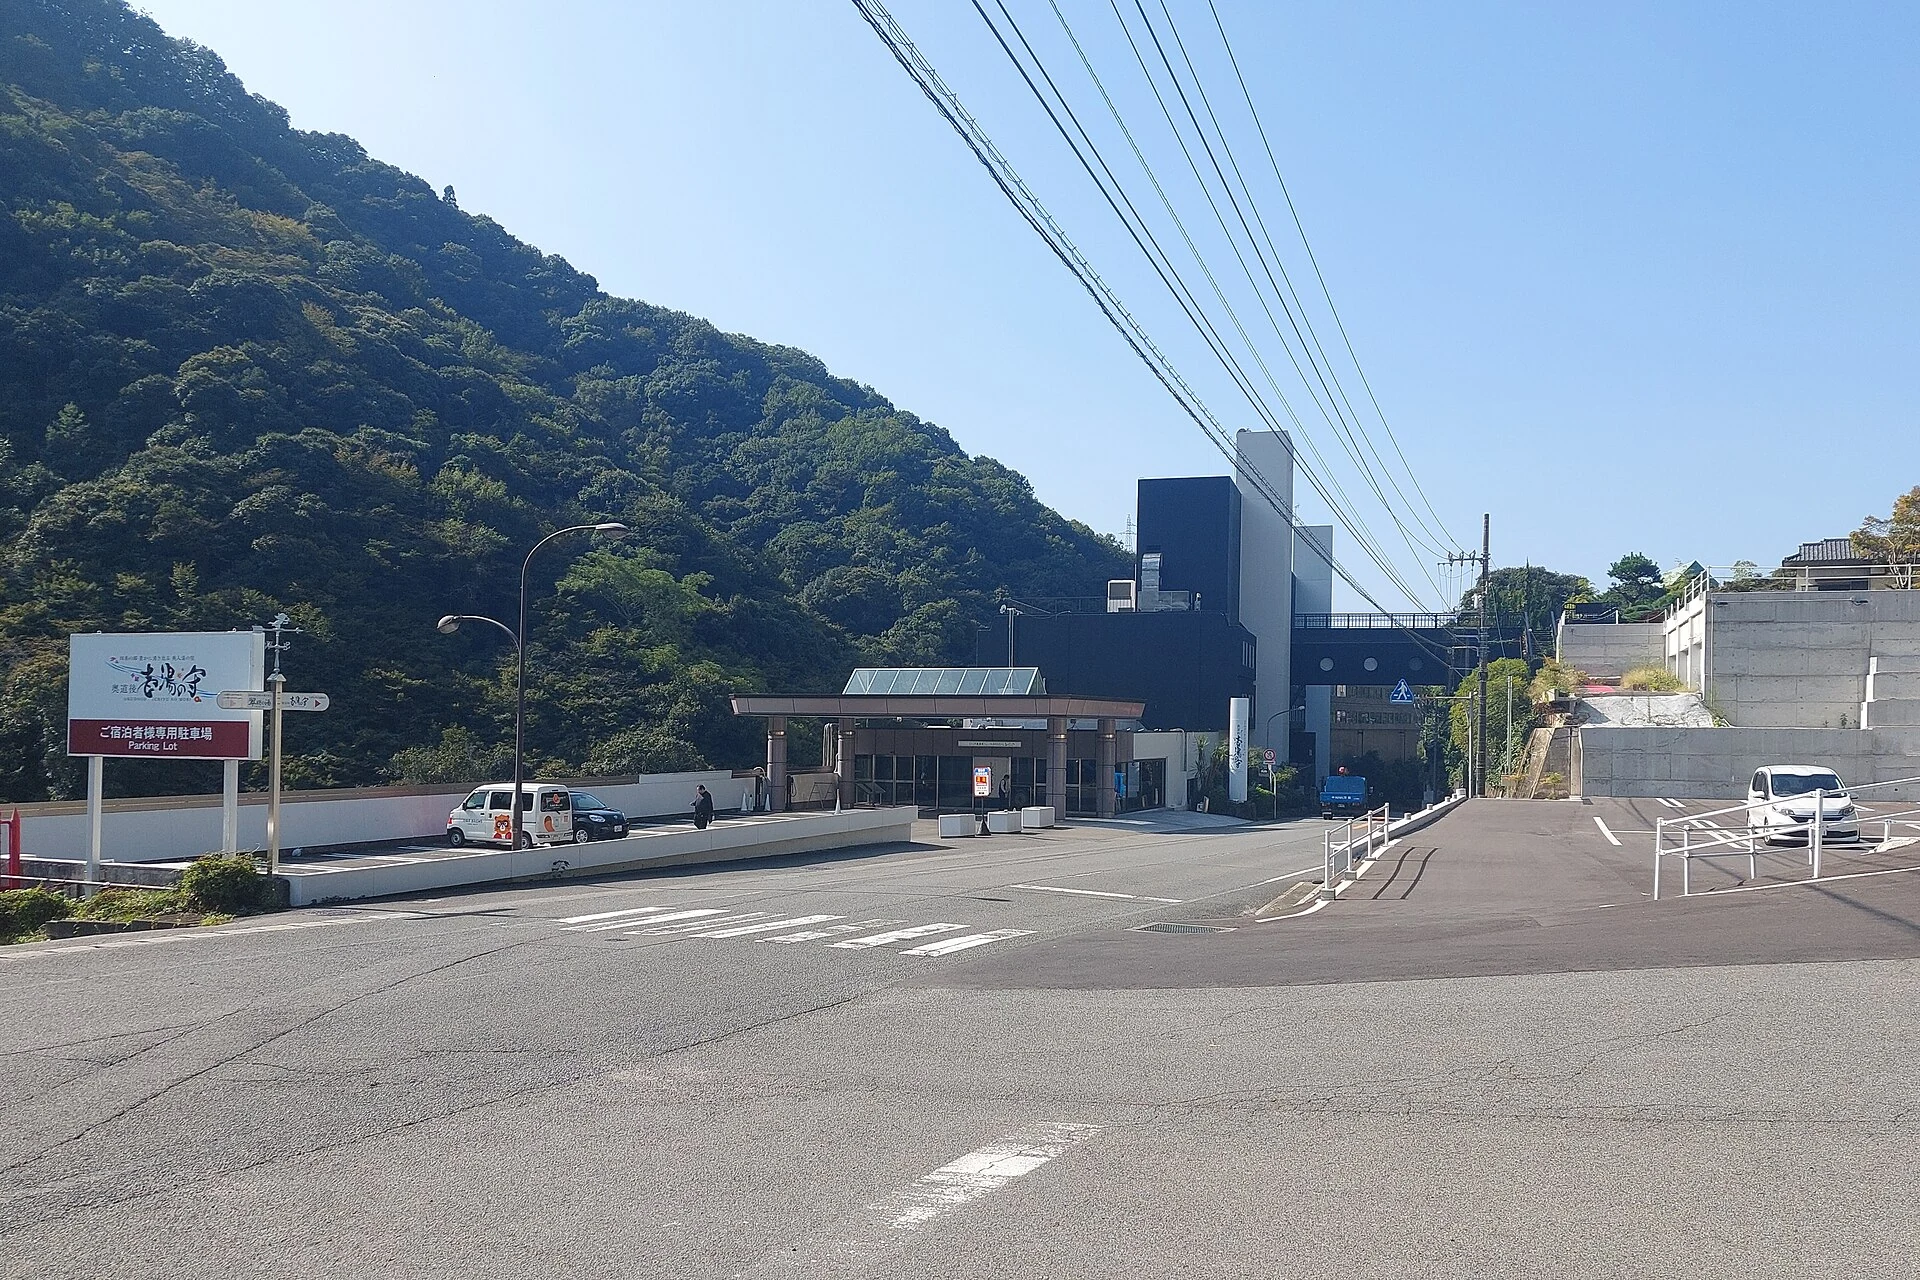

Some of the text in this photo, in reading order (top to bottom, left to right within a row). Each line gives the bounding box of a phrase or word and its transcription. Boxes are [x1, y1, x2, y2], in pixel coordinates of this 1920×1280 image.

[111, 684, 137, 694] 奥道後
[100, 725, 213, 741] ご宿泊者様専用駐車場
[128, 741, 178, 751] Parking Lot
